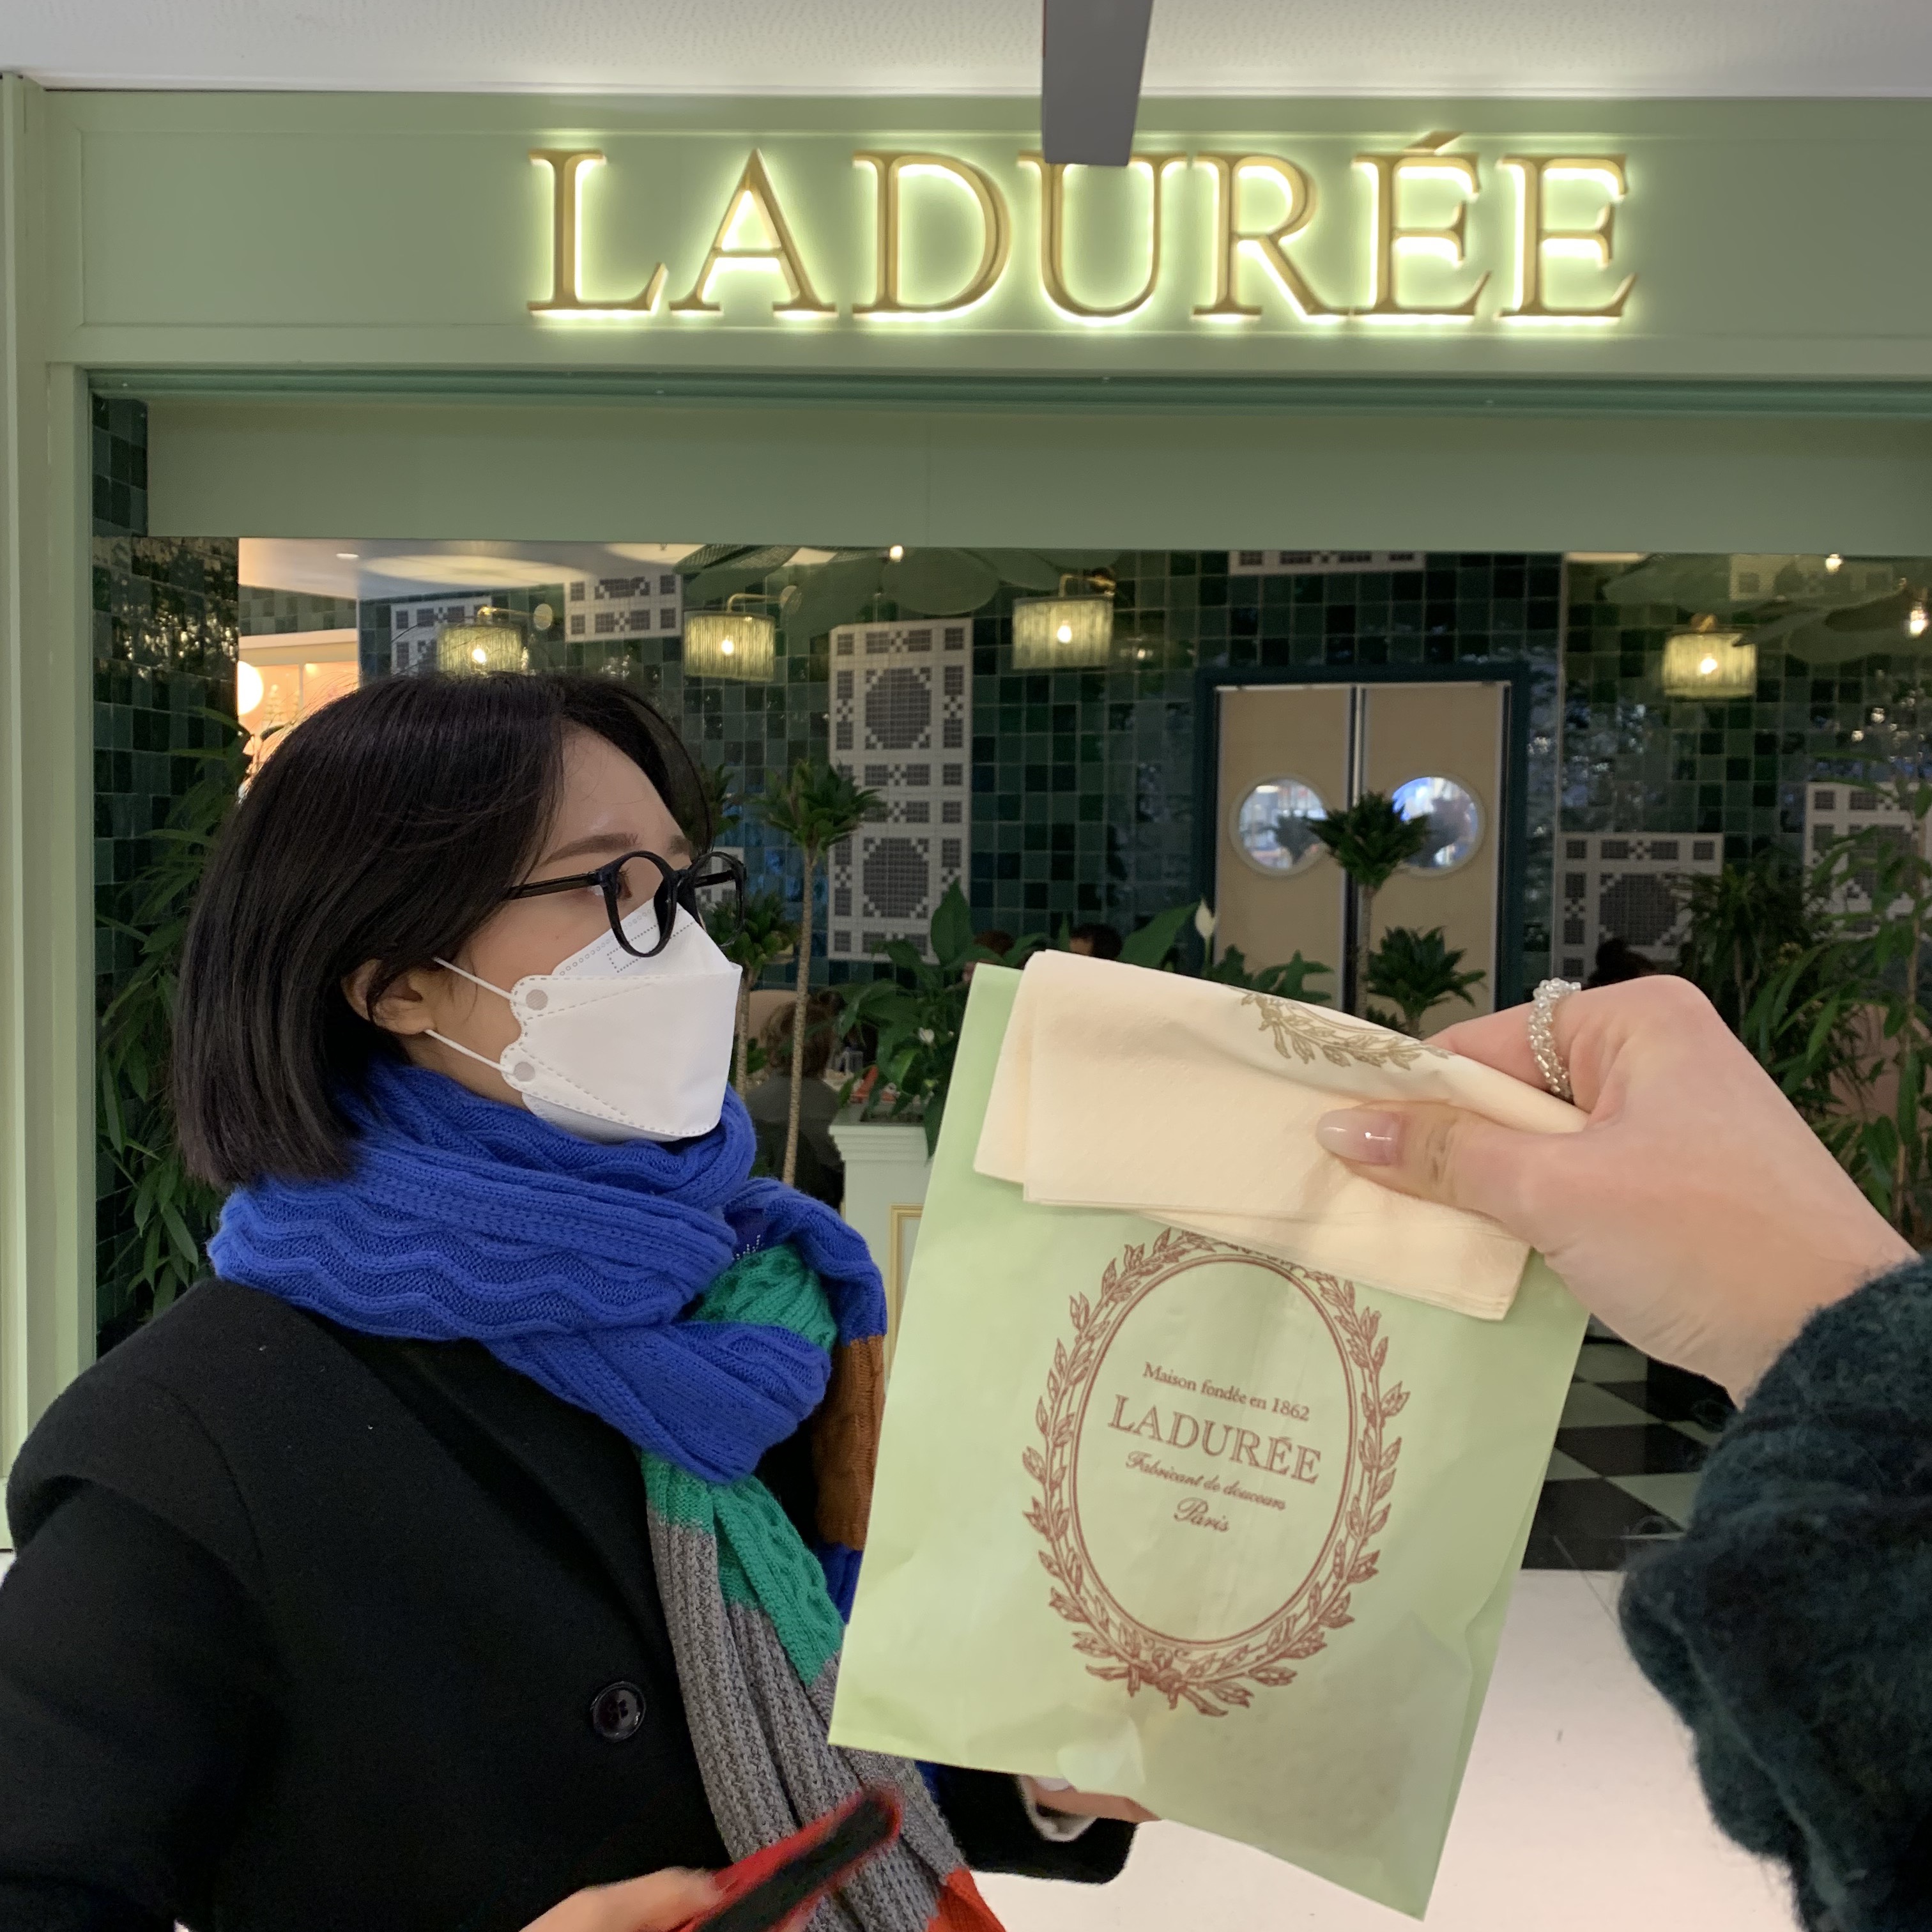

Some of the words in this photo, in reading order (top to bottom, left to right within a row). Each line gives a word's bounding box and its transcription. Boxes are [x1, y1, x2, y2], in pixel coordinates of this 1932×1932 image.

[526, 130, 1637, 317] LADURÉE
[1142, 1361, 1197, 1391] Maison
[1200, 1379, 1246, 1404] fondée
[1250, 1396, 1266, 1410] en
[1271, 1397, 1310, 1421] 1862
[1108, 1394, 1321, 1484] LADURÉE
[1203, 1475, 1220, 1491] de
[1174, 1497, 1229, 1532] Paris
